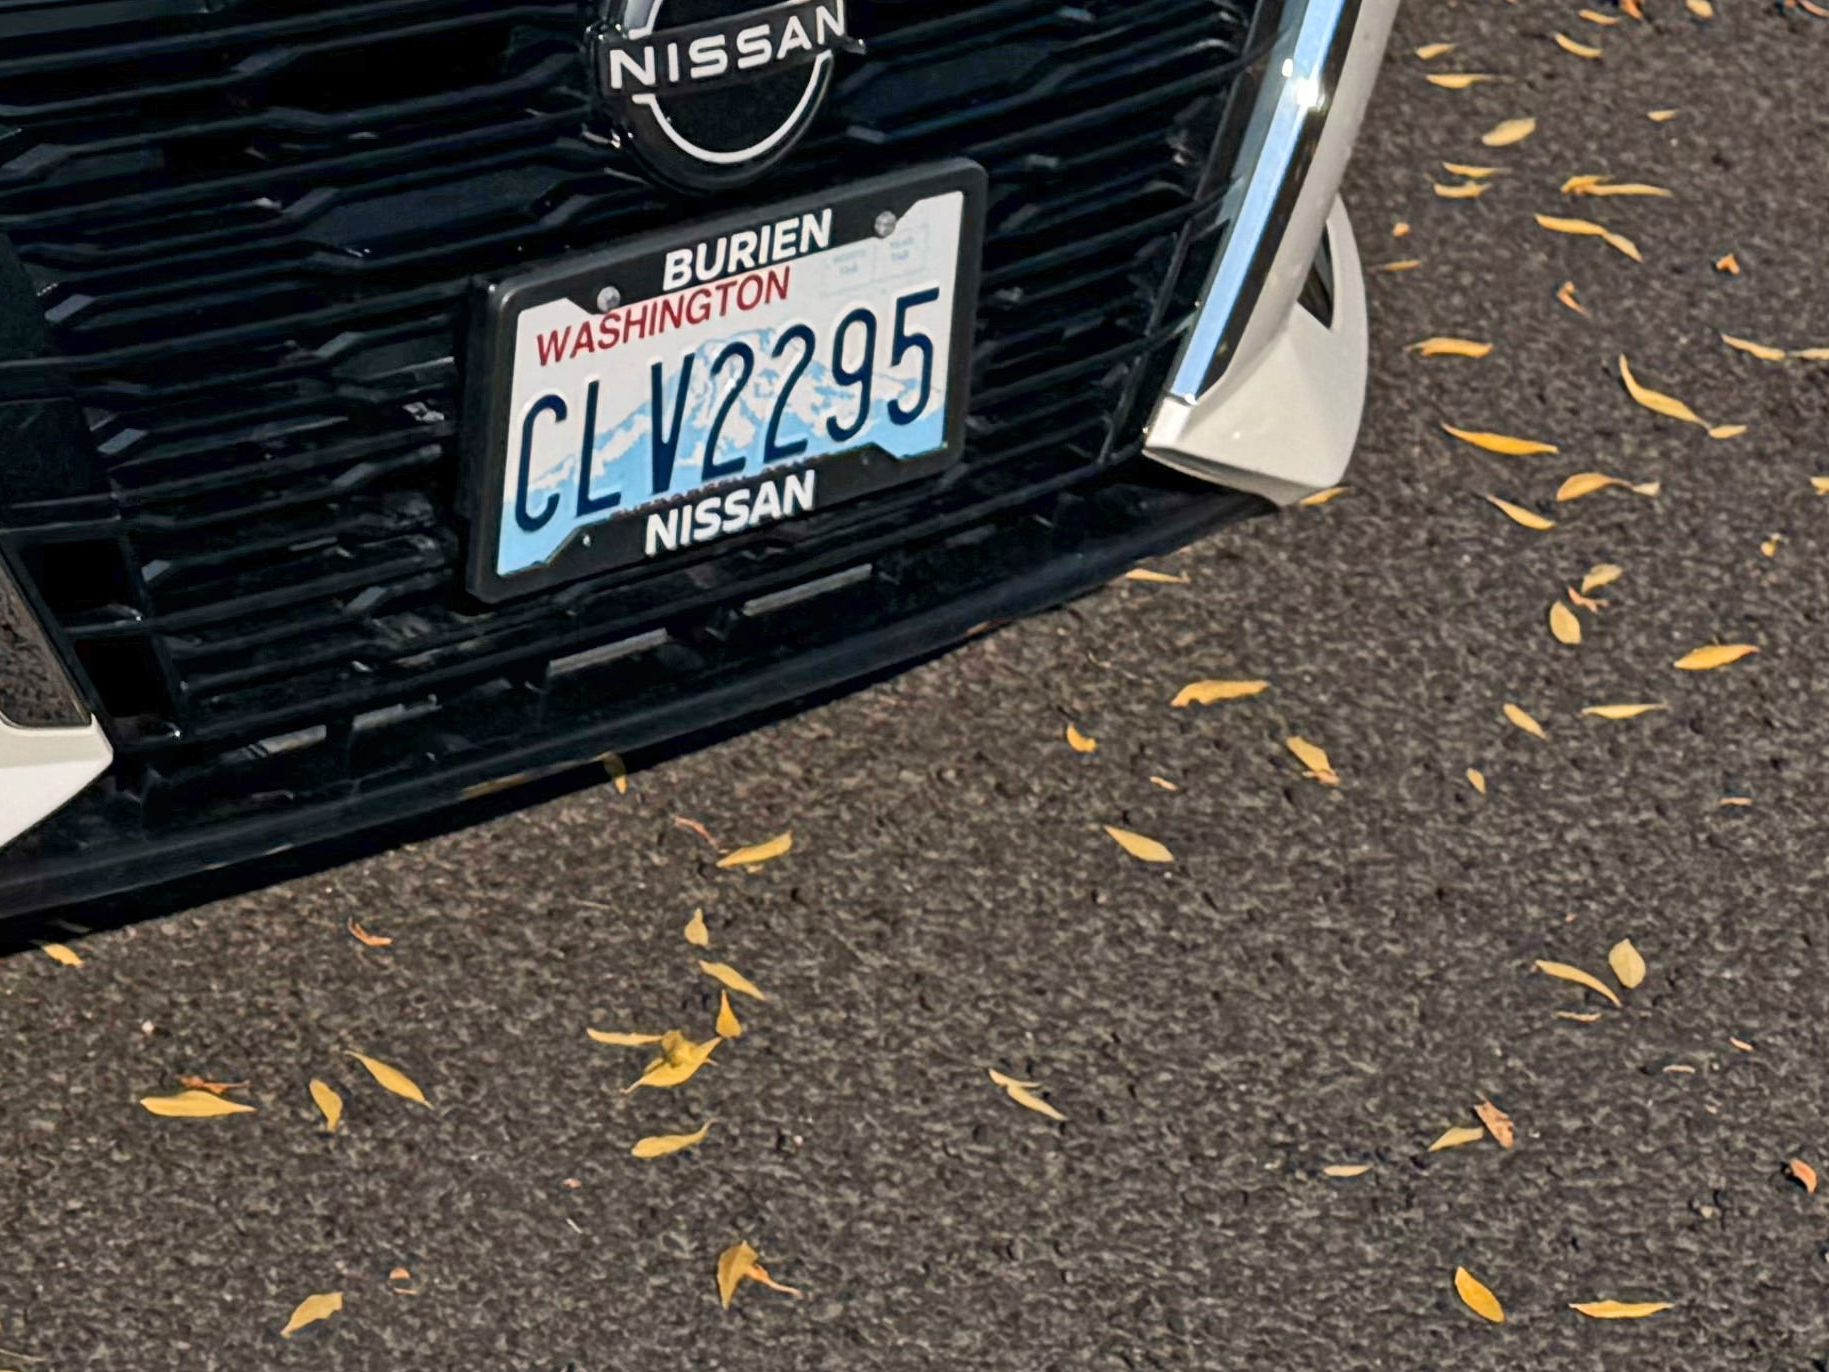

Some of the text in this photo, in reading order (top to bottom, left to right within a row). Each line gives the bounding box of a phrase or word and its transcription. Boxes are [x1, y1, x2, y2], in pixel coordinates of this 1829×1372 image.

[662, 208, 833, 292] BURIEN
[536, 266, 791, 367] WASHINGTON
[514, 286, 940, 533] CLV2295
[644, 469, 817, 556] NISSAN
